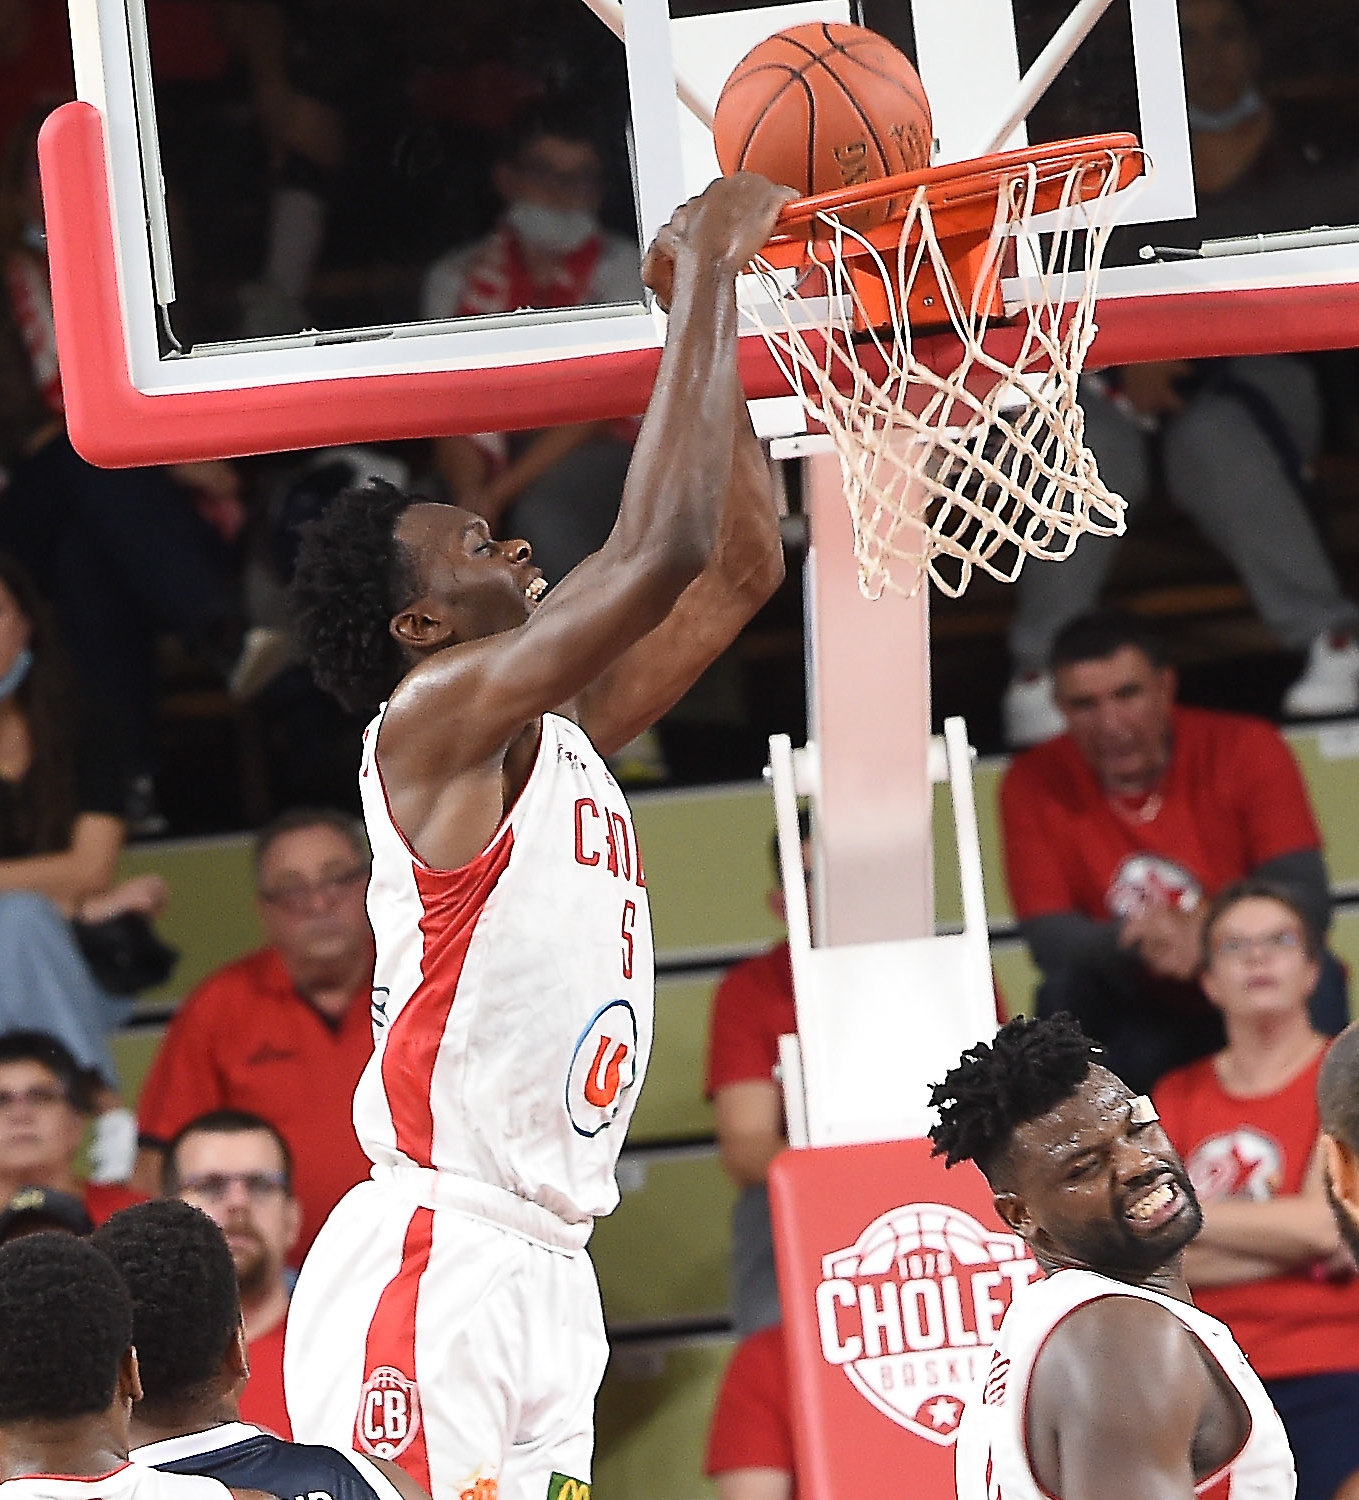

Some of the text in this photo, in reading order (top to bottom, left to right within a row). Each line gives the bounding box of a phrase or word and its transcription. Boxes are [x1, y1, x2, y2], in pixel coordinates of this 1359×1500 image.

[584, 1034, 628, 1108] U
[816, 1258, 1040, 1365] CHOLET
[364, 1390, 407, 1440] CB
